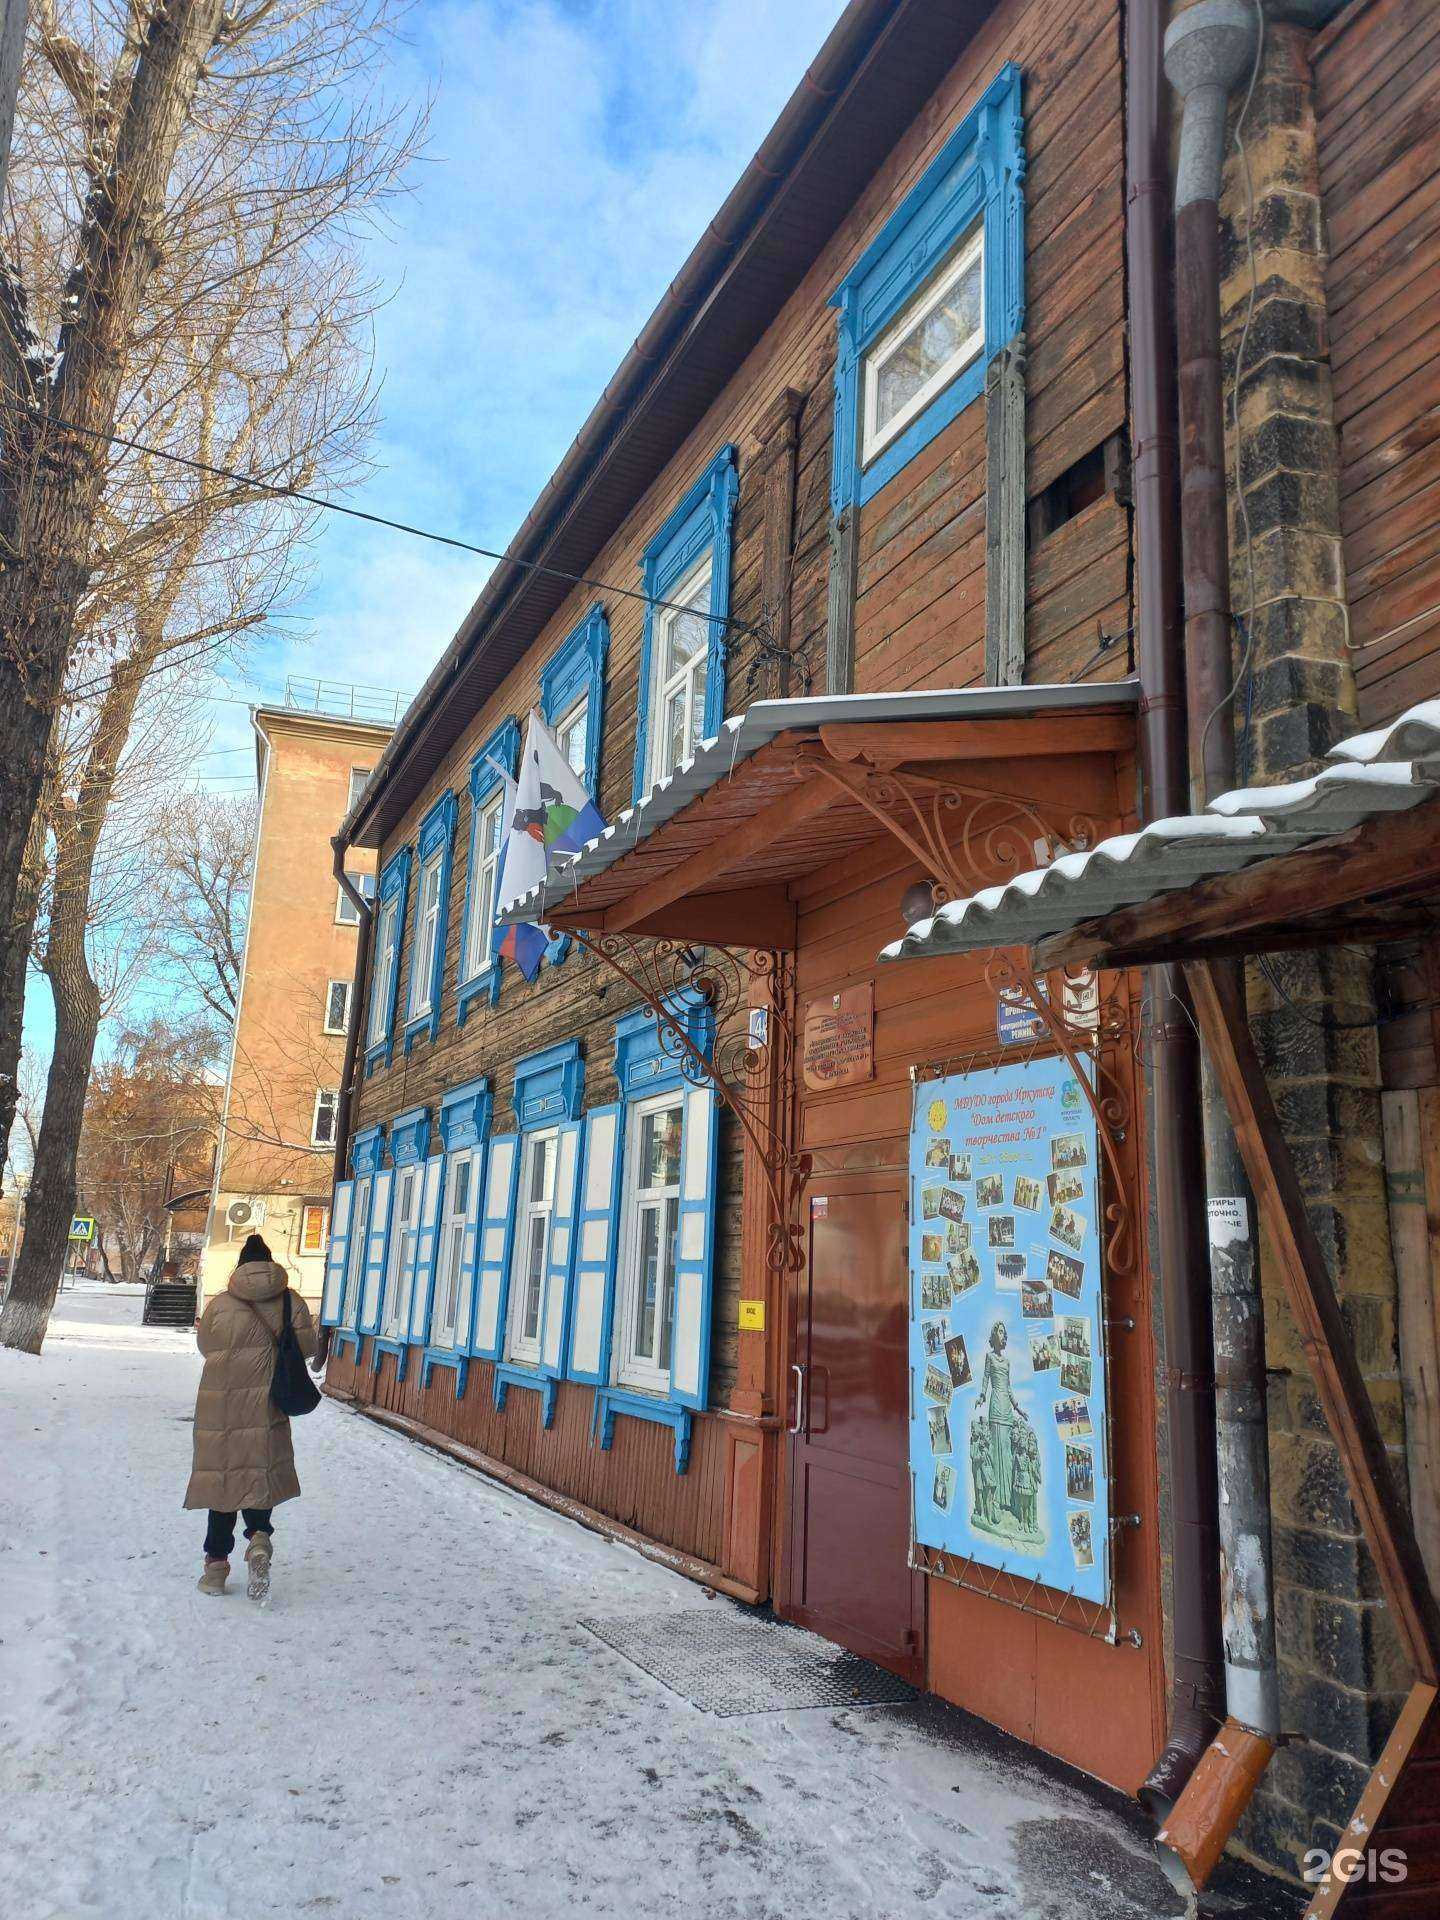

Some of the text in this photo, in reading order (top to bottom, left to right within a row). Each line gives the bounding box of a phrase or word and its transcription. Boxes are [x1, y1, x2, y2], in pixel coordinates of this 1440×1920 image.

[988, 1088, 1013, 1109] города
[1014, 1085, 1056, 1104] Иркутска
[995, 1109, 1036, 1126] детского
[965, 1130, 1021, 1149] творчества
